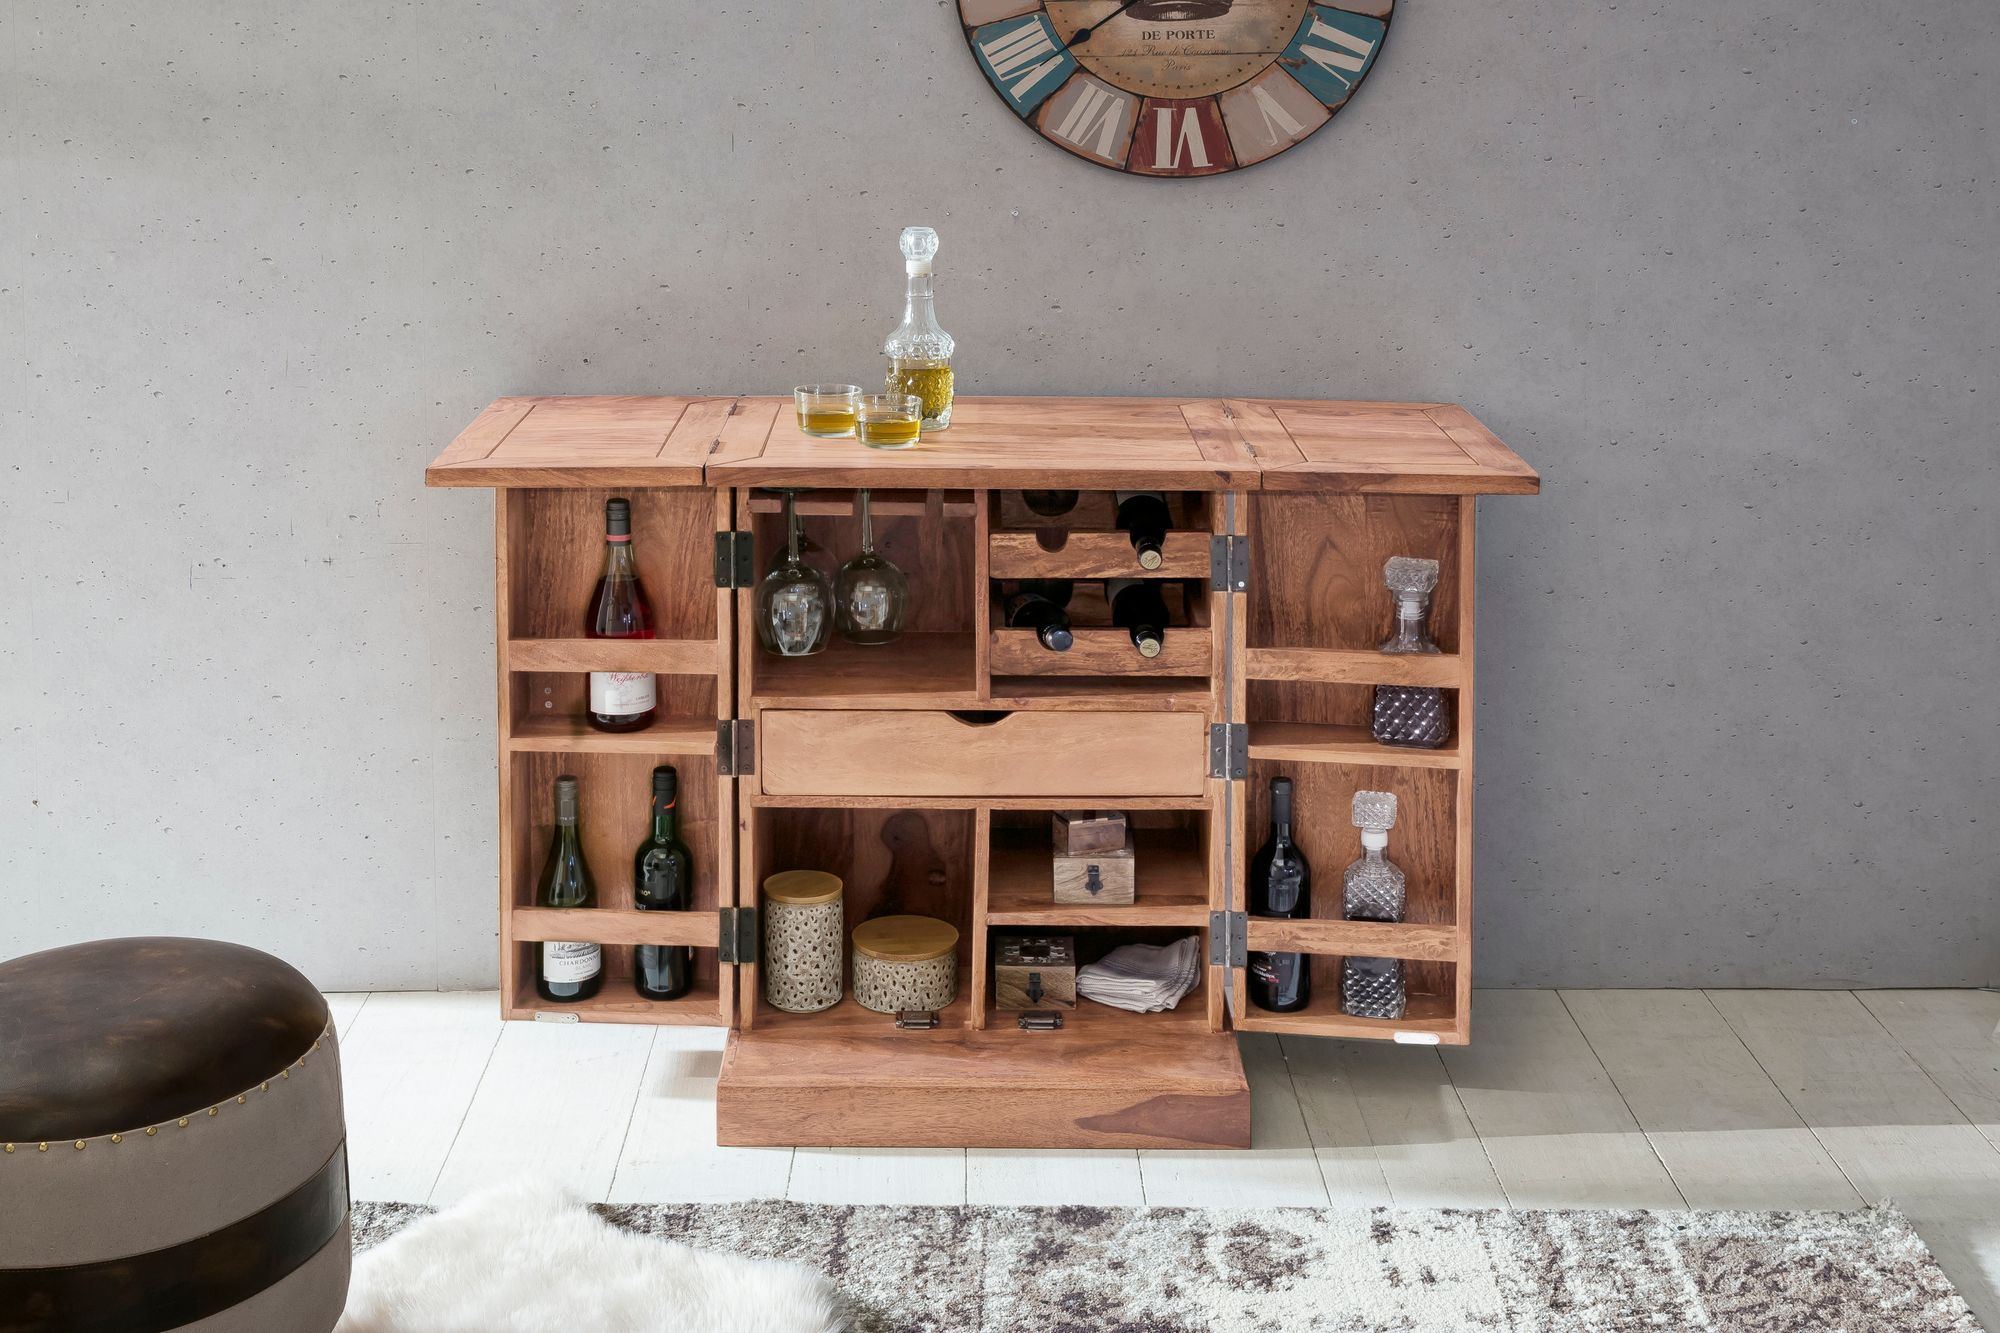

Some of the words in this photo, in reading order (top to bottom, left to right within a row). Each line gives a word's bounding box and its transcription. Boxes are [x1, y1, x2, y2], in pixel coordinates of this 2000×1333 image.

[979, 15, 1064, 103] VIII
[1142, 31, 1161, 40] DE
[1166, 29, 1216, 40] PORTE
[1142, 44, 1167, 56] Rue
[1168, 45, 1180, 56] de
[1161, 59, 1192, 71] Paris
[1299, 15, 1375, 90] IV
[1052, 80, 1125, 160] VII
[1151, 107, 1213, 169] VI
[1251, 84, 1307, 147] V
